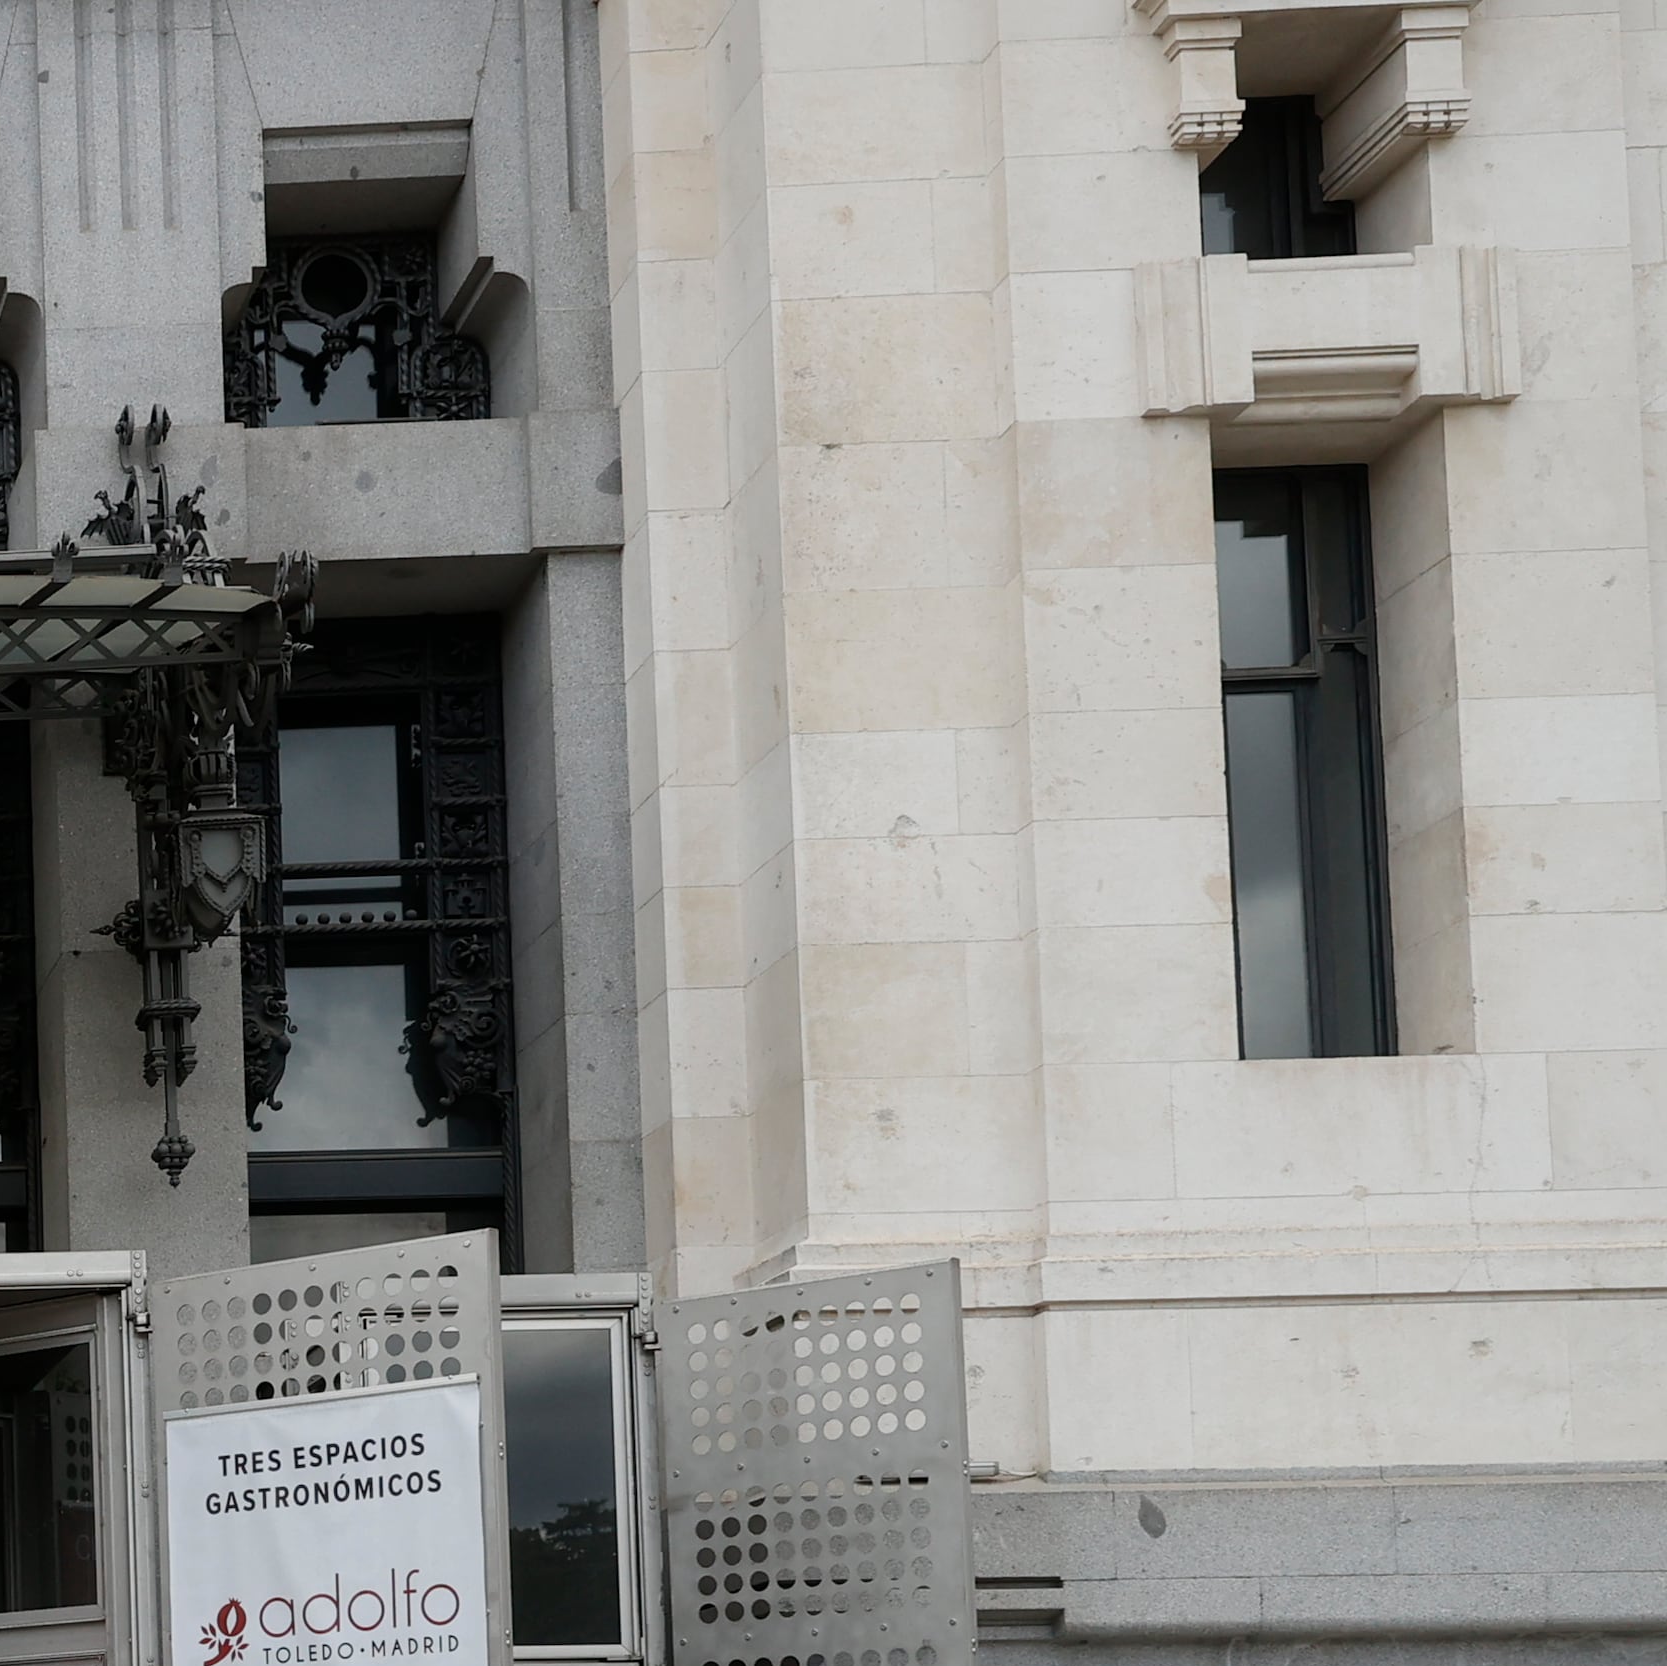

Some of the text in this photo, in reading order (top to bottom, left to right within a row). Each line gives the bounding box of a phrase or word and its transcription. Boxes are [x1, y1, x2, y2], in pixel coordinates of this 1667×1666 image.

[218, 1433, 425, 1477] TRES ESPACIOS
[205, 1469, 442, 1515] GASTRONÓMICOS
[259, 1568, 460, 1638] adolfo
